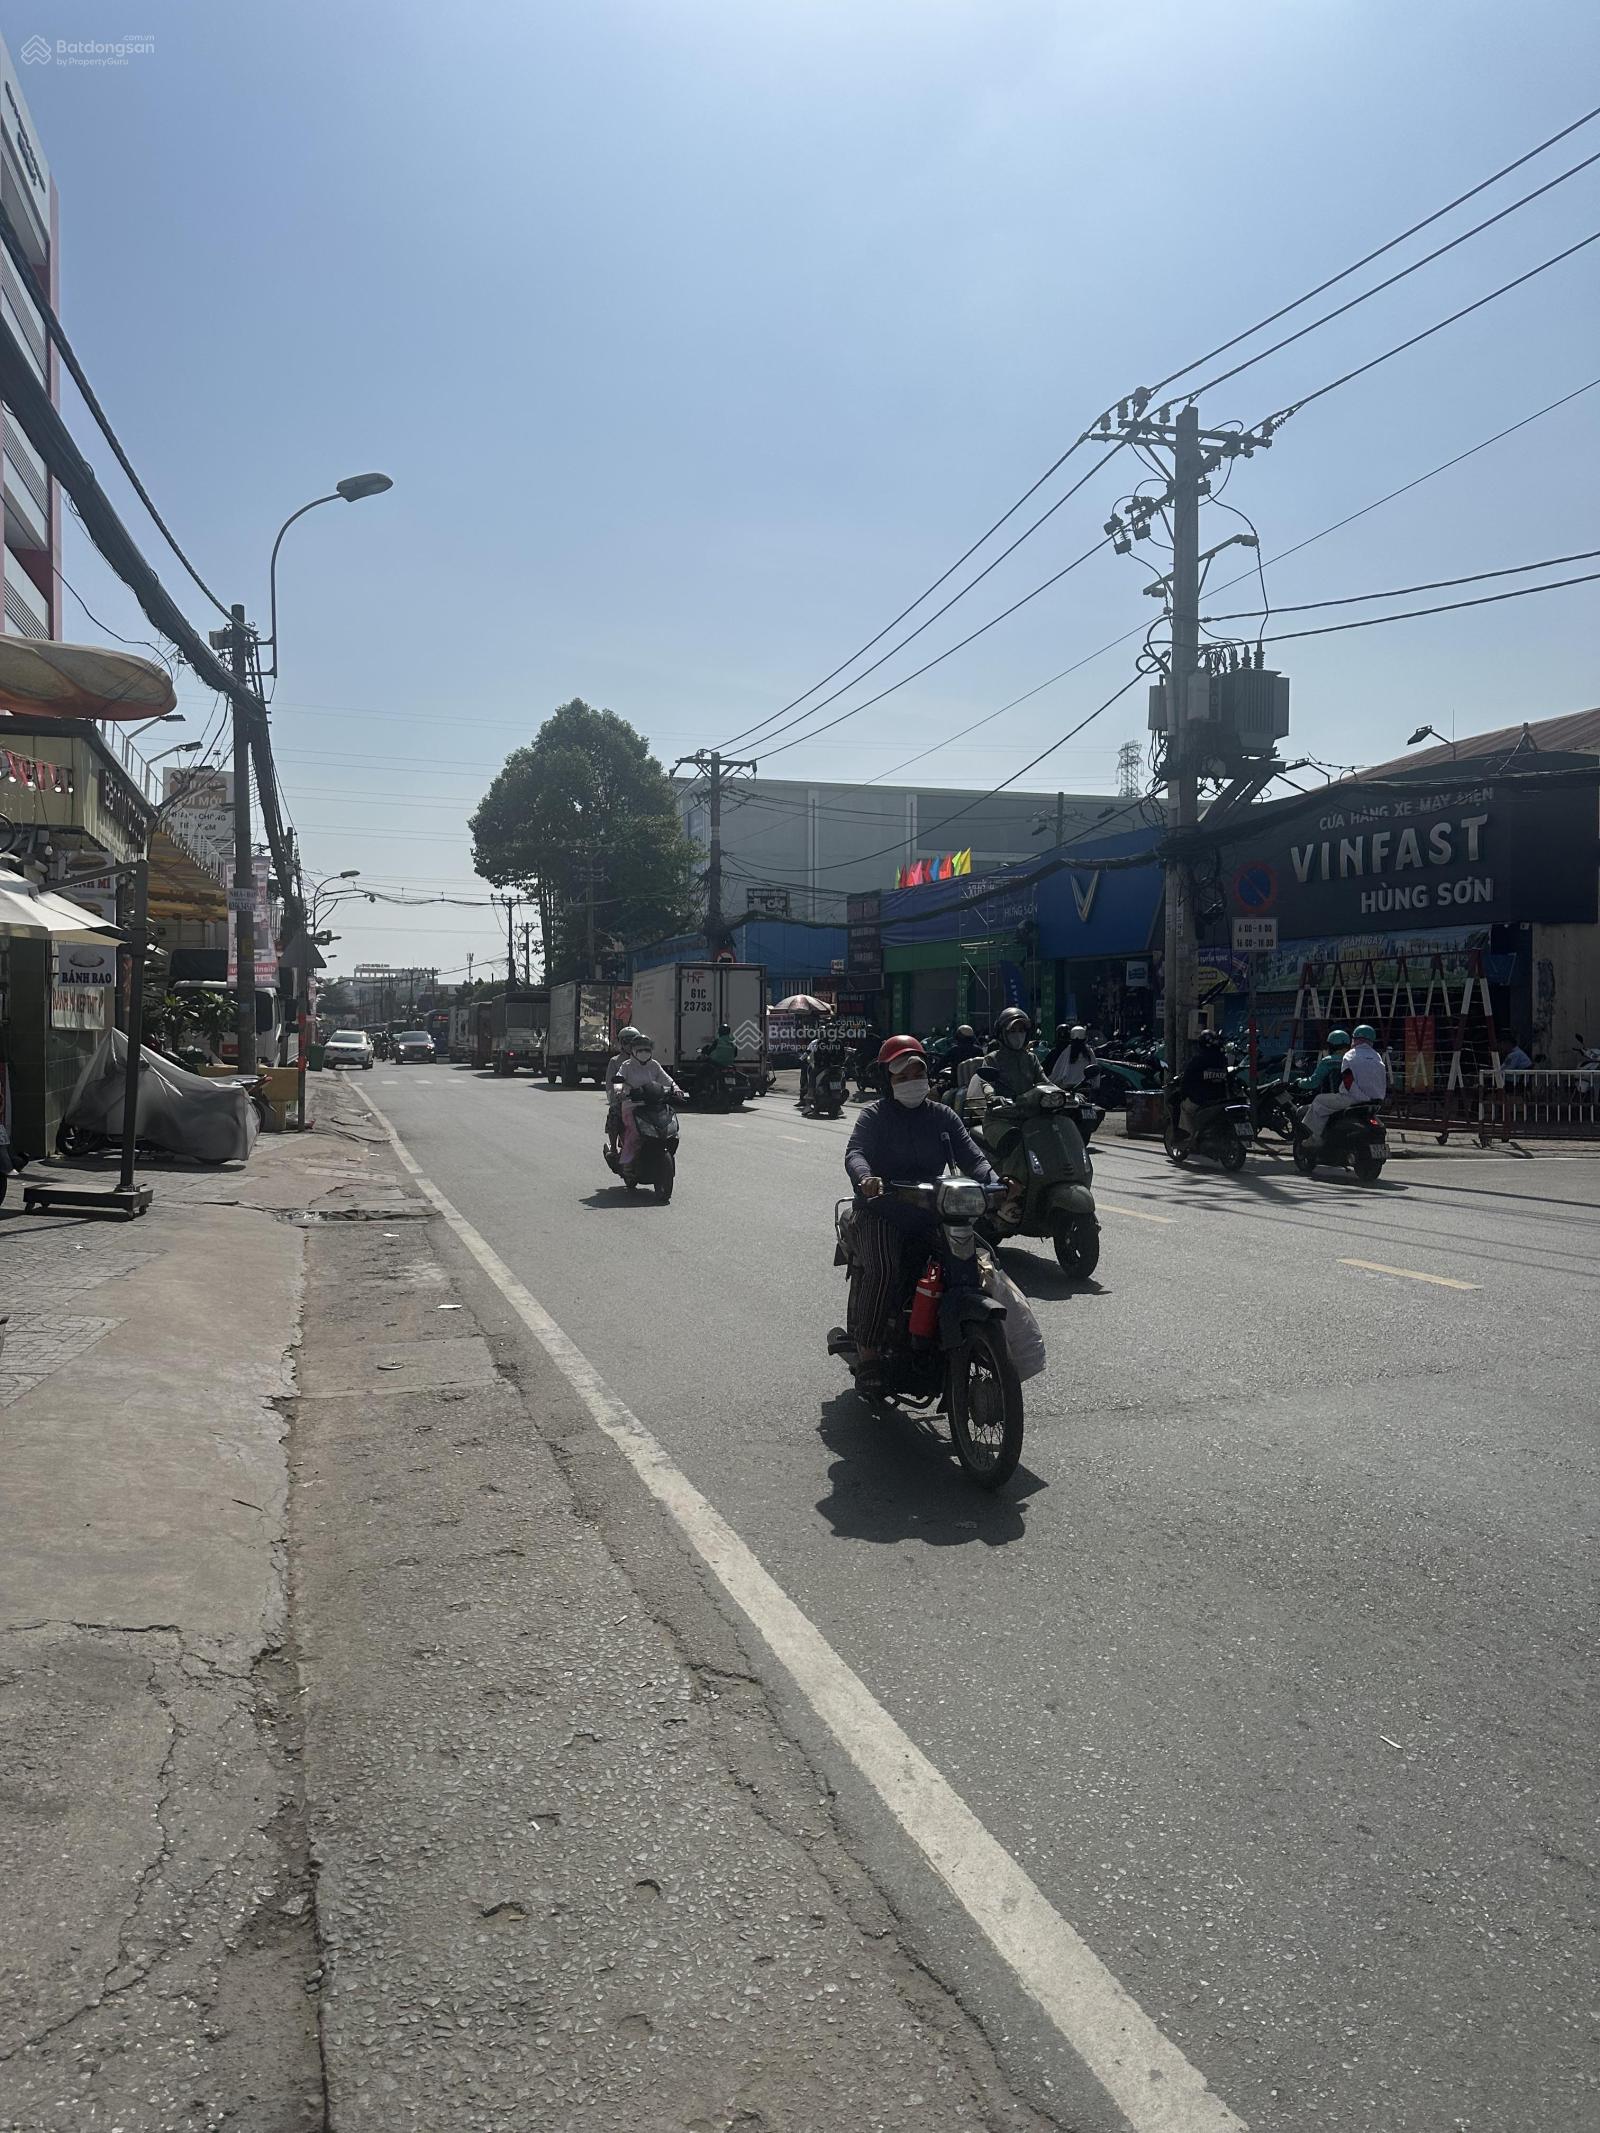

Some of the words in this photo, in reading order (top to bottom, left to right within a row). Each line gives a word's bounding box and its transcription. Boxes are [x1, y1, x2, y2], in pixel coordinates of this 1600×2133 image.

[1394, 801, 1414, 817] XE
[1289, 814, 1489, 884] VINFAST
[1360, 882, 1429, 914] HÙNG
[1437, 876, 1495, 906] SƠN
[62, 968, 90, 984] BÁNH
[92, 972, 113, 984] BAO
[690, 988, 707, 999] 61C
[684, 1001, 713, 1013] 23733
